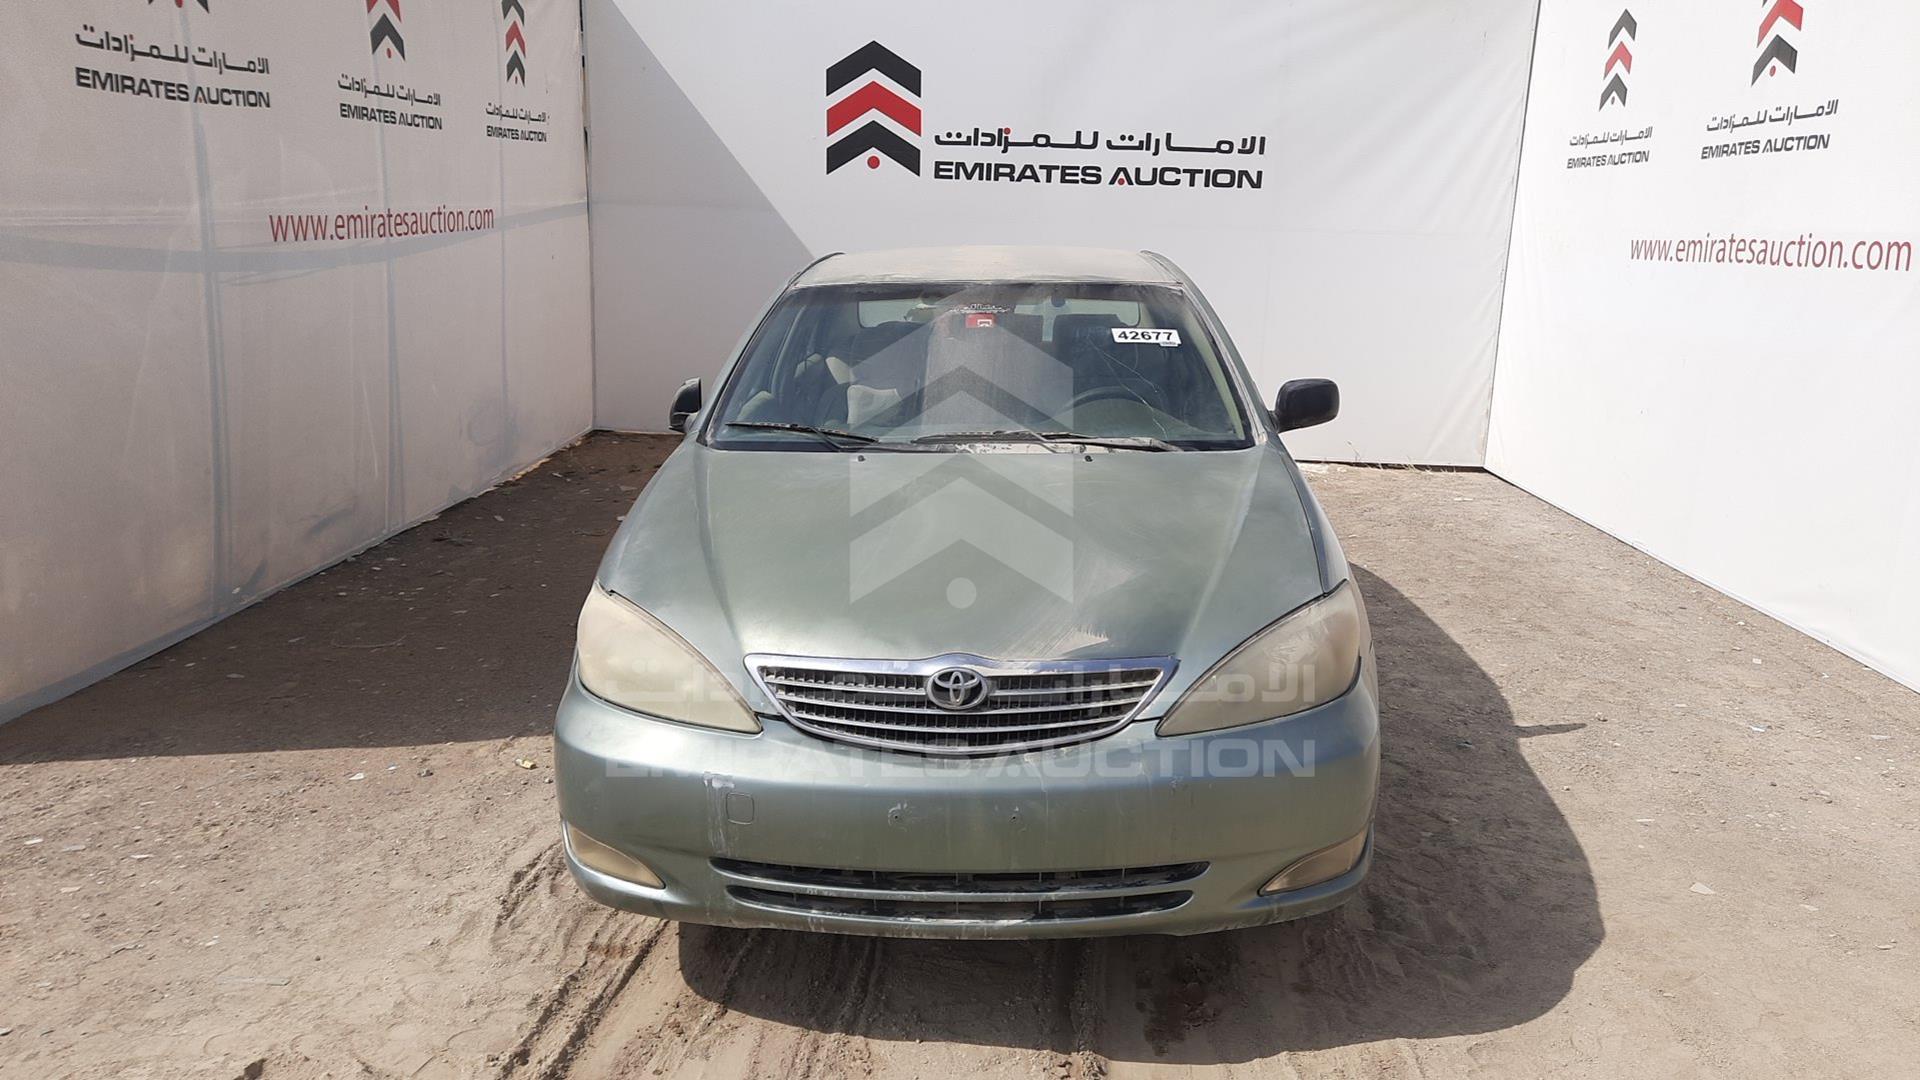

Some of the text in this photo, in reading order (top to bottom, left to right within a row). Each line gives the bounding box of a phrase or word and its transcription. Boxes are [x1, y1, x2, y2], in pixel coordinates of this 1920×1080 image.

[75, 67, 271, 108] EMIRATES AUCTION
[340, 103, 443, 130] EMIRATES AUCTION
[486, 125, 519, 140] EMIRATES
[934, 126, 1267, 157] الامارات للمزادات
[1700, 133, 1831, 160] EMIRATES AUCTION
[1567, 150, 1650, 169] EMIRATES AUCTION
[933, 160, 1263, 189] EMIRATES AUCTION
[269, 205, 495, 242] www.emiratesauction.com
[1630, 232, 1913, 272] www.emiratesauction.com
[1118, 331, 1173, 341] 42677
